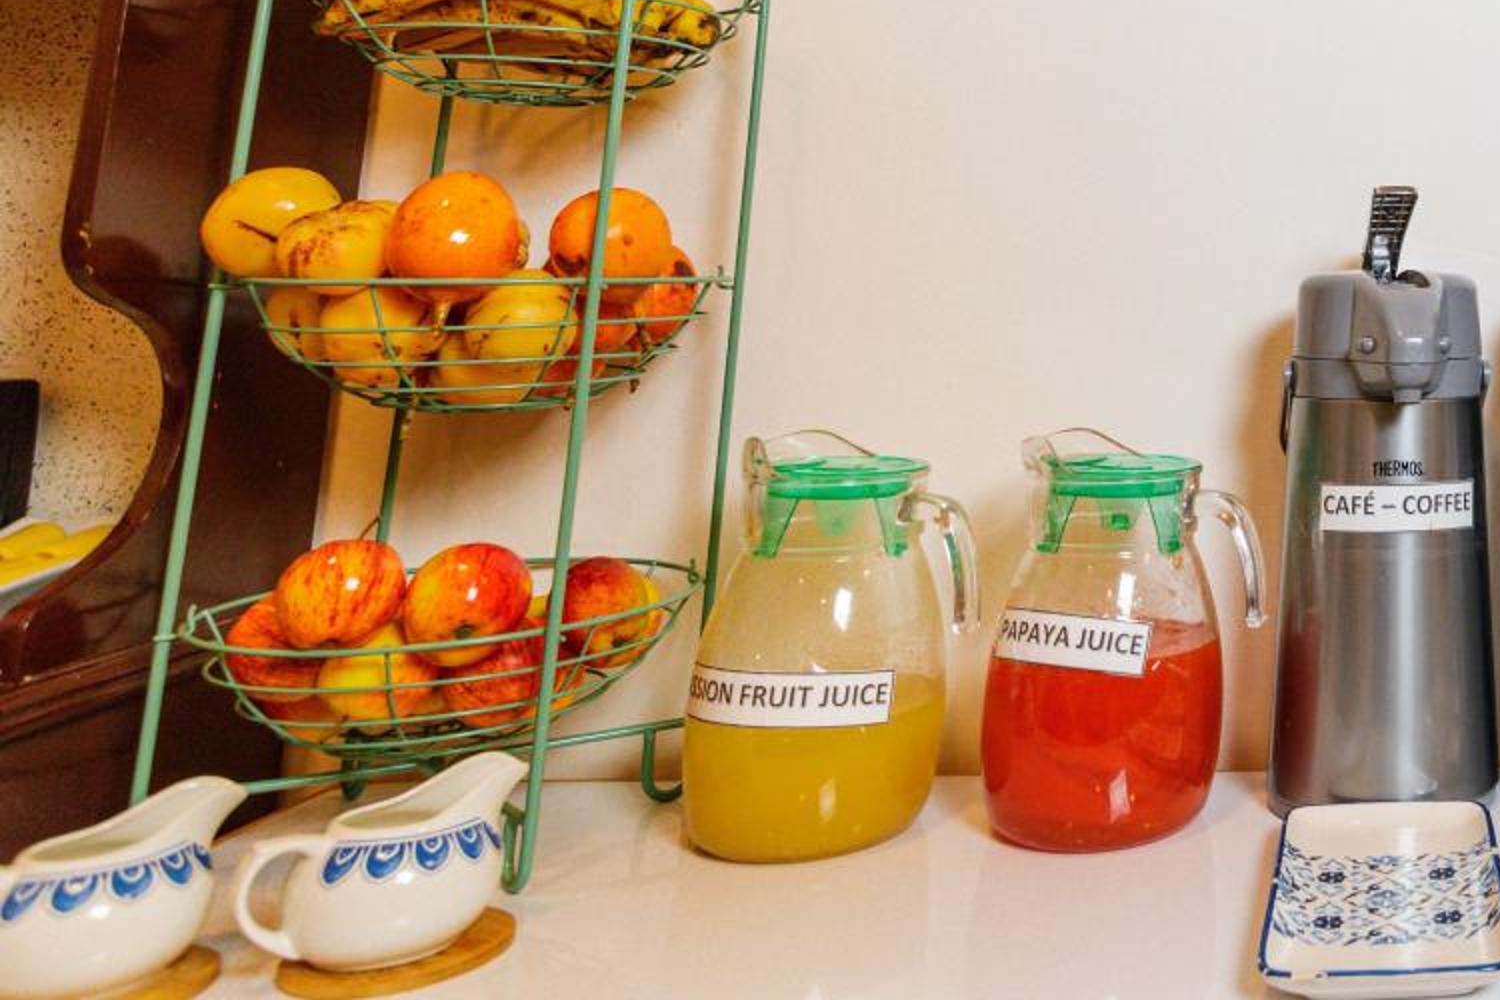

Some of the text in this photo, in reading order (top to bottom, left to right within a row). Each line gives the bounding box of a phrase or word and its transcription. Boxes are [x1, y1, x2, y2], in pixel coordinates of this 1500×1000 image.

[1373, 460, 1424, 477] THERMOS
[1323, 489, 1375, 515] CAFÉ
[1402, 492, 1471, 515] COFFEE
[1076, 628, 1145, 656] JUICE
[739, 684, 813, 708] FRUIT
[819, 683, 888, 707] JUICE
